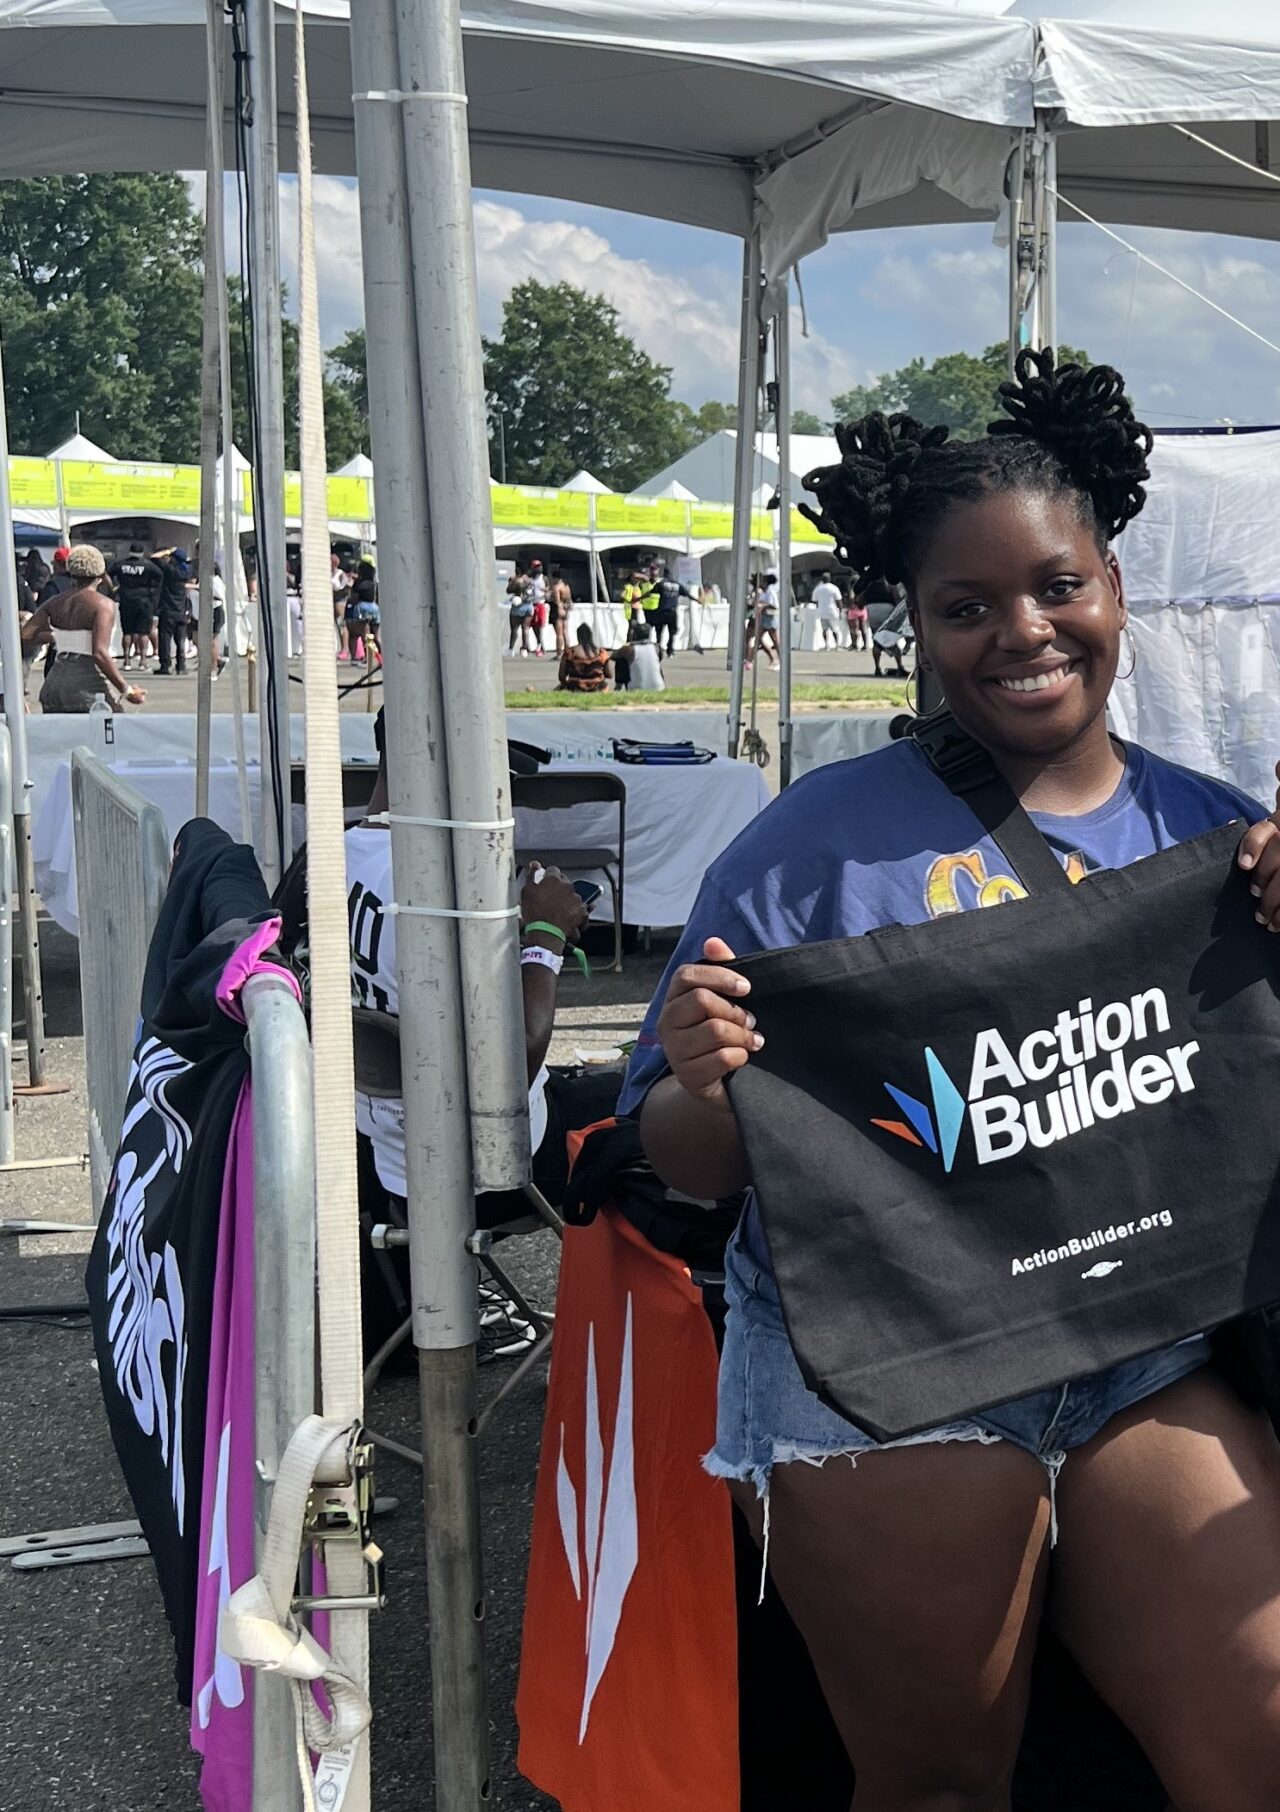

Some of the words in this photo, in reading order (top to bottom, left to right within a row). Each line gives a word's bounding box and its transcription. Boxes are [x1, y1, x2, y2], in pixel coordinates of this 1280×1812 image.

[967, 986, 1171, 1102] Action
[968, 1040, 1200, 1166] Builder
[1010, 1208, 1174, 1277] ActionBuilder.org
